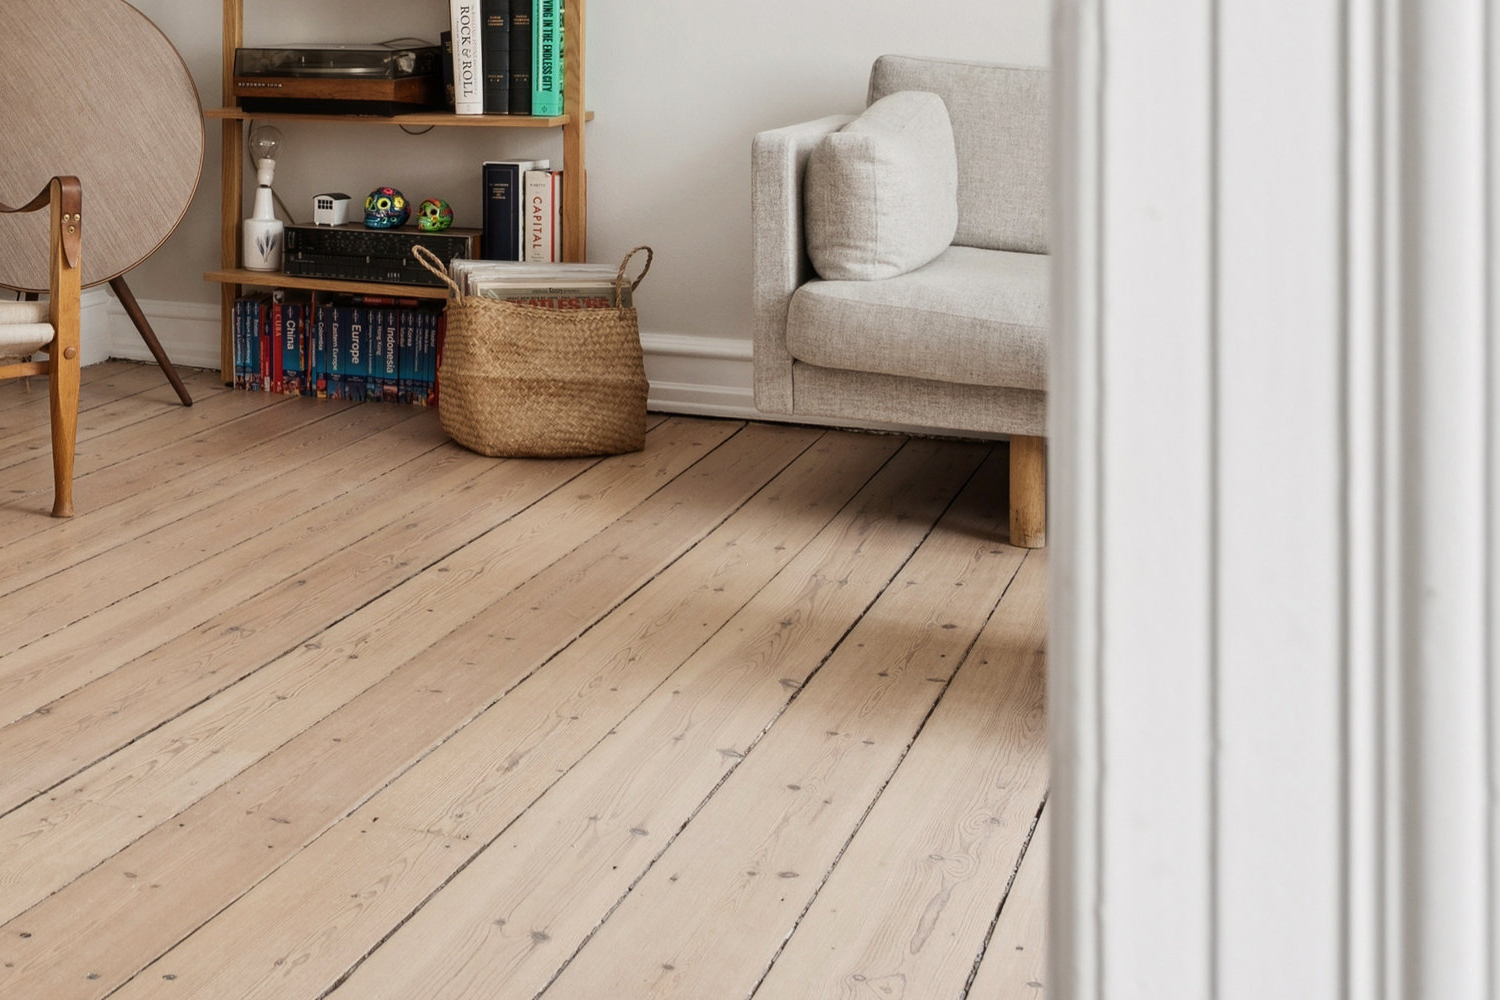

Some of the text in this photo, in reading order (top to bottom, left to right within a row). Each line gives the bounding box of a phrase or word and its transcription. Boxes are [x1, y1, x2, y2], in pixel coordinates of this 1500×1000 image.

[542, 19, 553, 27] IN
[542, 28, 553, 43] THE
[459, 6, 473, 98] ROCK & ROLL
[542, 44, 553, 75] ENDLESS
[542, 76, 552, 92] CITY
[532, 196, 543, 249] CAPITAL
[274, 314, 282, 337] CUBA
[286, 319, 297, 350] China
[317, 321, 325, 351] Colombia
[349, 324, 361, 364] Europe
[375, 326, 383, 356] Hong Kong
[386, 327, 396, 374] Indonesia
